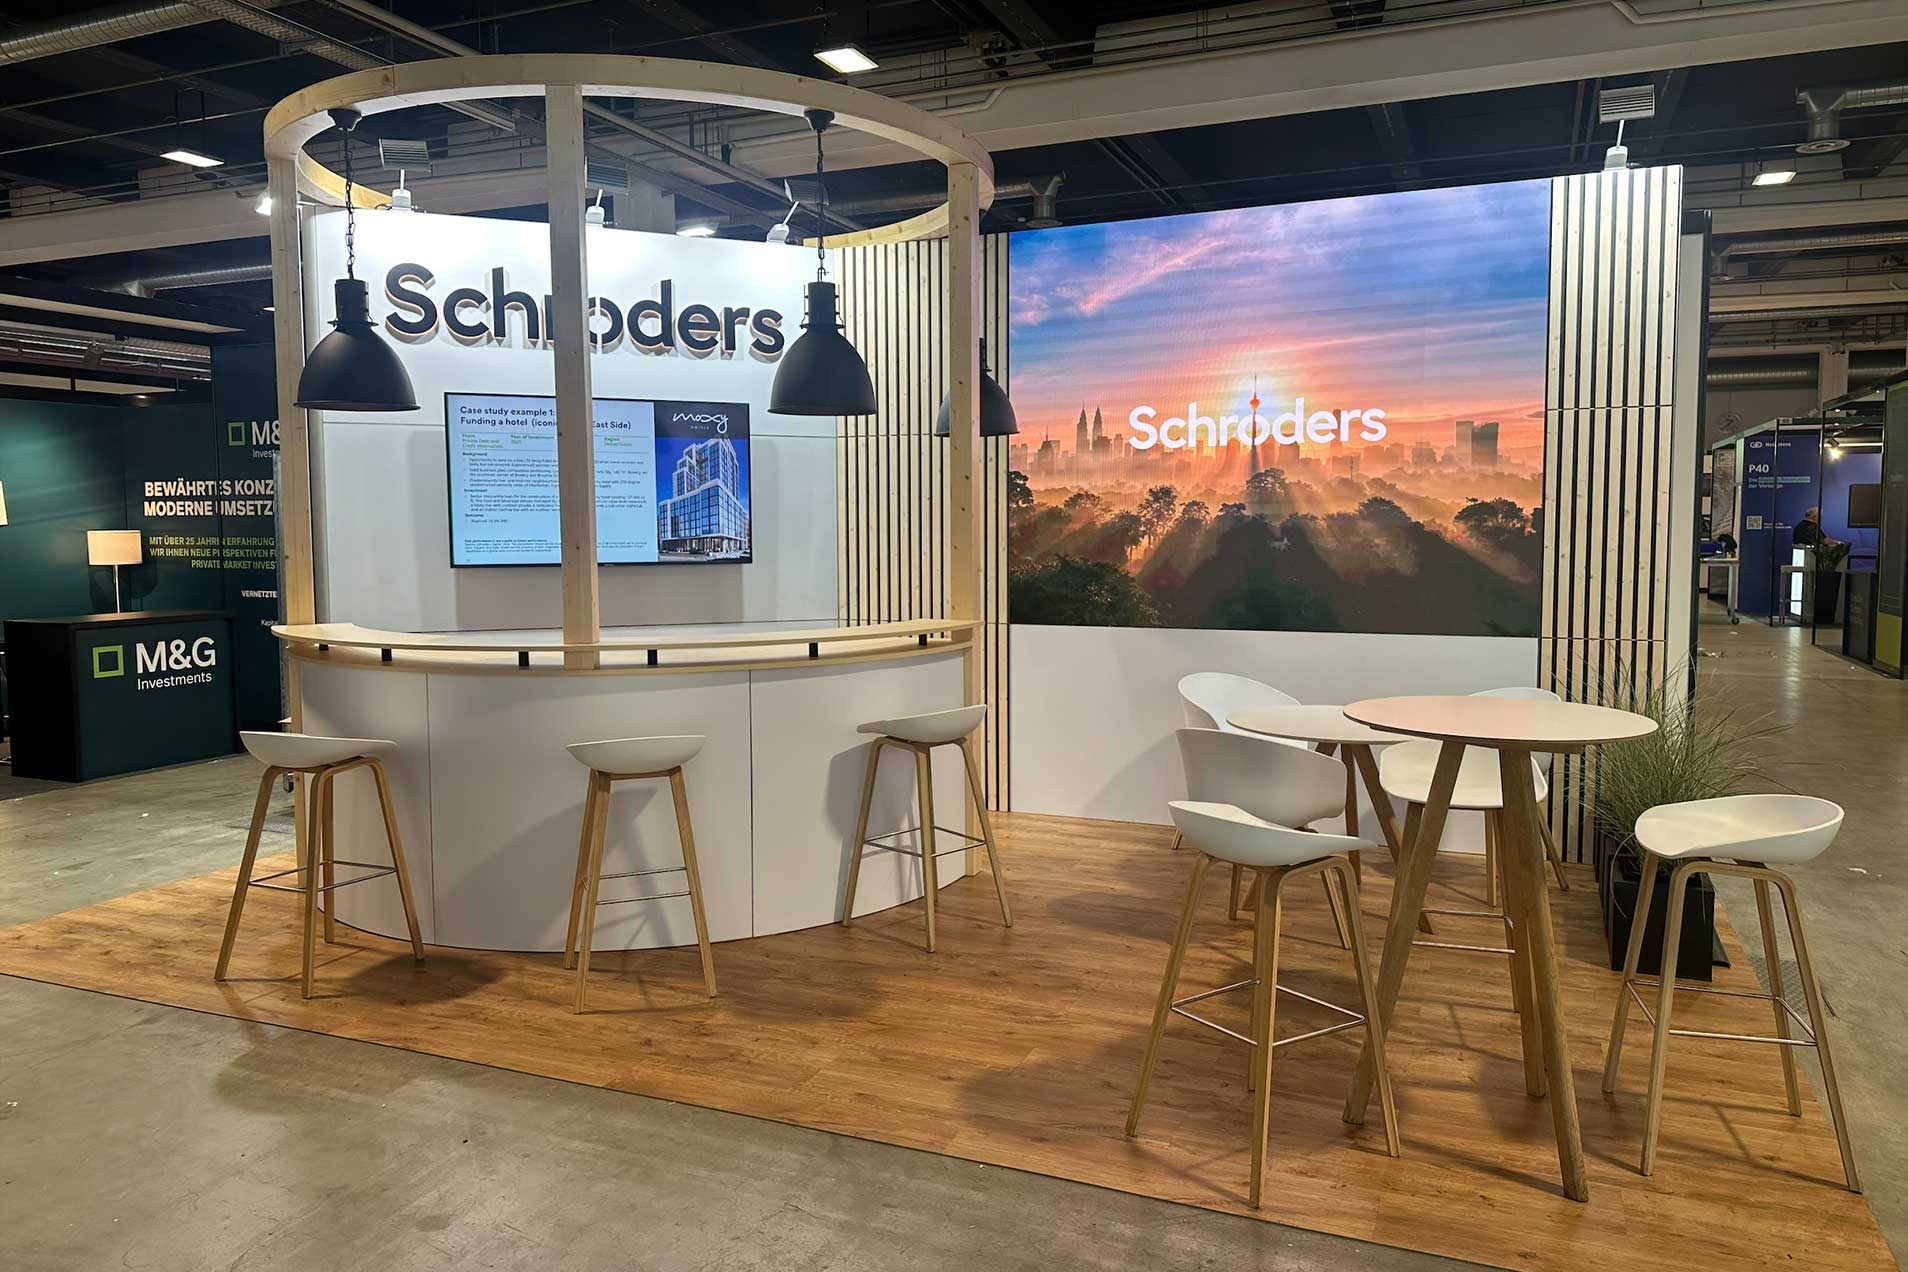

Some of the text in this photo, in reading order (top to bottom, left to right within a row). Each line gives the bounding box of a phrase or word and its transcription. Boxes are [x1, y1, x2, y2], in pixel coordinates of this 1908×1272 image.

[460, 406, 482, 414] Case
[484, 408, 508, 416] study
[510, 408, 547, 417] example
[460, 417, 496, 426] Funding
[505, 418, 528, 426] hotel
[531, 418, 557, 427] (iconi
[610, 420, 631, 430] Side)
[1128, 397, 1387, 450] Schroders
[1748, 464, 1769, 473] P40
[235, 479, 275, 496] KONZ
[144, 501, 213, 516] MODERNE
[149, 536, 163, 545] MIT
[163, 535, 185, 545] ÜBER
[186, 537, 195, 545] 25
[226, 537, 275, 546] ERFAHRUNG
[150, 548, 165, 557] WIR
[165, 548, 189, 557] IHNEN
[190, 548, 211, 557] NEUE
[191, 560, 220, 569] PRIVATE
[136, 637, 216, 674] M&G
[137, 672, 213, 690] Investments
